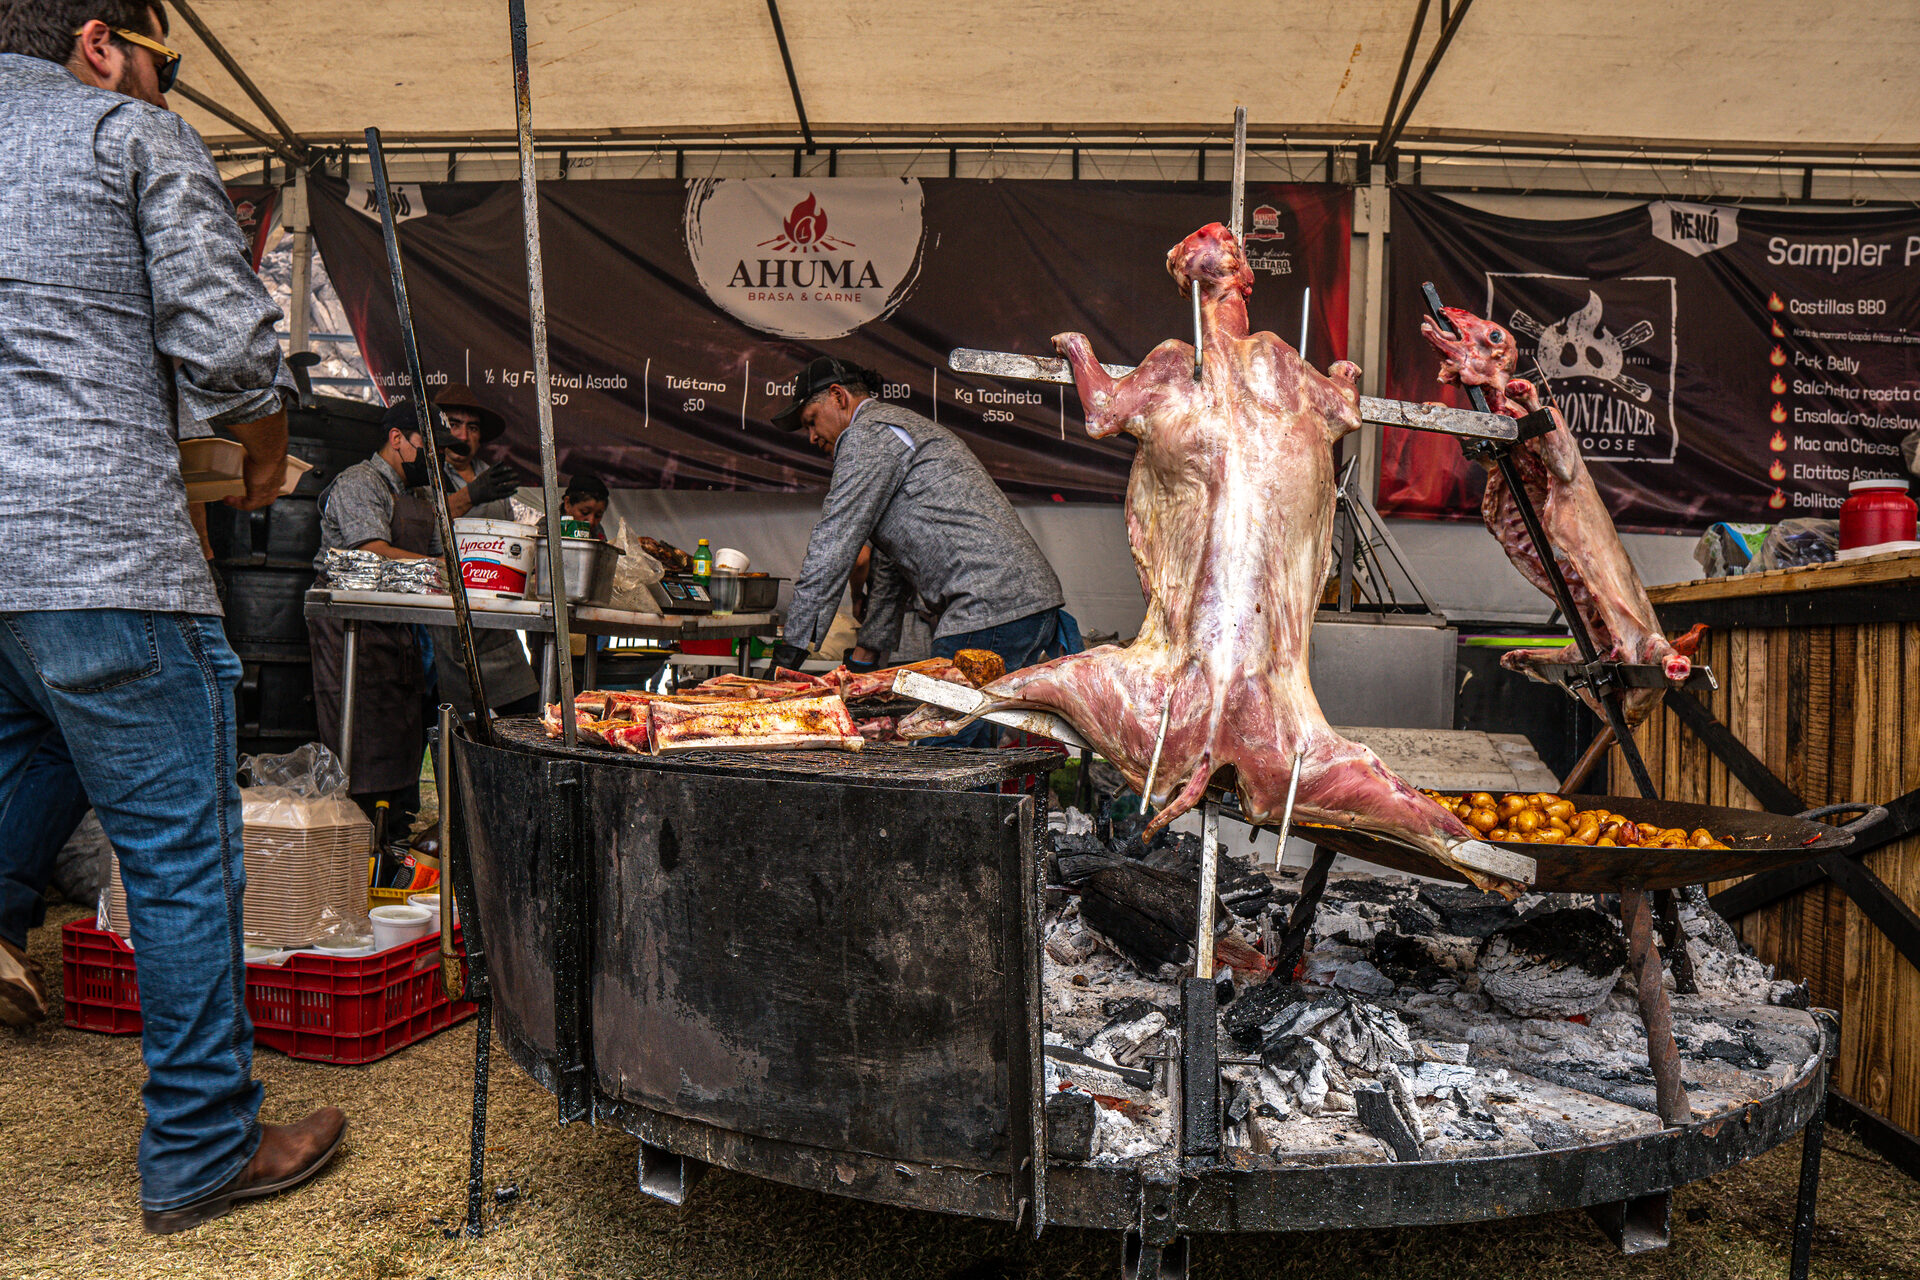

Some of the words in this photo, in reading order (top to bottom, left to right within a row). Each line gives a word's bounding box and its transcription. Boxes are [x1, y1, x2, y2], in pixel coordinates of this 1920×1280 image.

[363, 186, 411, 216] MNÚ
[1670, 208, 1719, 244] MENÚ
[1249, 257, 1290, 268] ERÉTARO
[1767, 237, 1891, 274] Sampler
[726, 259, 883, 288] AHUMA
[748, 292, 794, 301] BRASA
[800, 292, 808, 301] &
[815, 292, 861, 302] CARNE
[1790, 299, 1854, 315] Costillas
[1827, 355, 1860, 375] Belly
[425, 370, 448, 385] ado
[502, 368, 519, 387] kg
[523, 371, 582, 389] Ftival
[586, 374, 628, 389] Asado
[665, 375, 727, 392] Tuétano
[954, 388, 973, 404] Kg
[977, 389, 1042, 405] Tocineta
[1863, 386, 1909, 401] receta
[683, 398, 705, 412] $50
[983, 410, 1015, 423] $550
[1794, 407, 1859, 425] Ensalada
[1580, 437, 1636, 451] OOSE
[1794, 435, 1820, 451] Mac
[1824, 438, 1848, 453] and
[1851, 438, 1900, 456] Cheese
[1793, 464, 1849, 480] Elotitos
[1793, 492, 1846, 508] Bollitos
[460, 538, 505, 555] Lyncott
[462, 562, 500, 579] Crema
